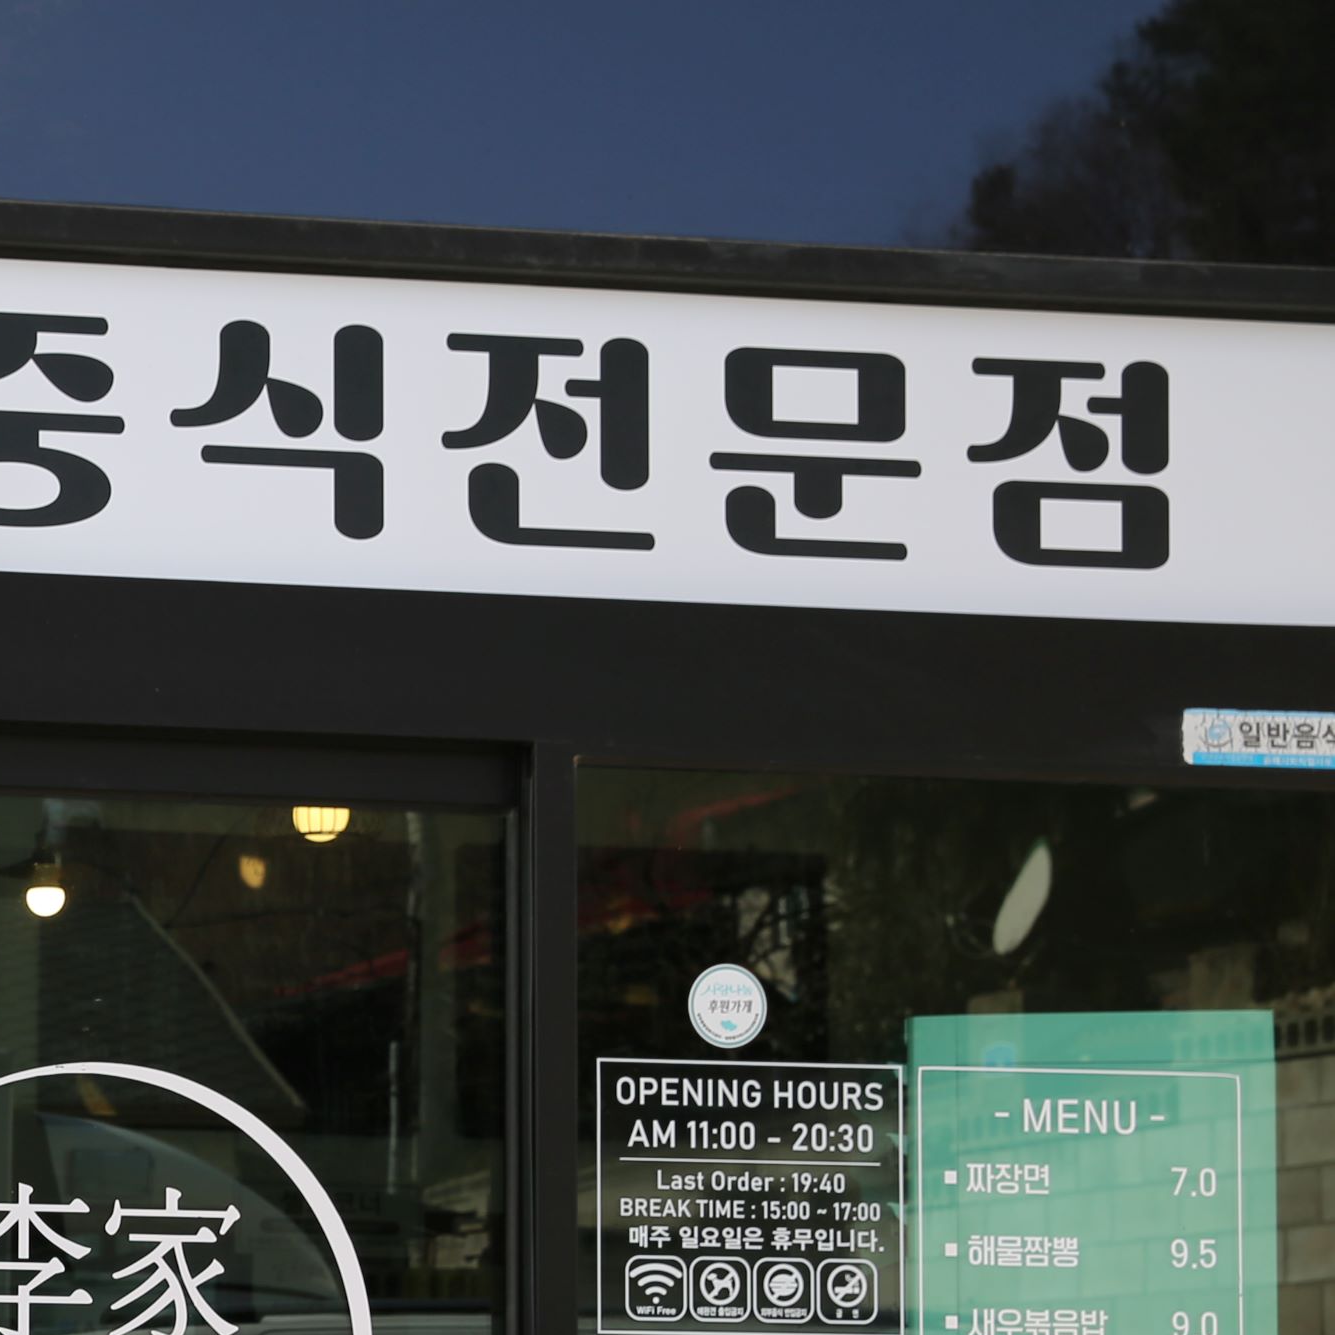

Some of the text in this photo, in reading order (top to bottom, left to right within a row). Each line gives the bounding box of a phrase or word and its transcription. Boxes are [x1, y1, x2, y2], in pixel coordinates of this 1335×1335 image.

[709, 999, 753, 1014] 후원가게
[615, 1075, 884, 1112] OPENING HOURS
[1022, 1098, 1137, 1135] MENU
[627, 1119, 676, 1148] AM
[686, 1121, 756, 1150] 11:00
[792, 1123, 874, 1153] 20:30
[657, 1169, 704, 1191] Last
[711, 1171, 774, 1192] Order
[791, 1172, 846, 1194] 19:40
[966, 1163, 1217, 1197] 짜장면 7.0
[619, 1197, 691, 1218] BREAK
[696, 1199, 746, 1219] TIME
[761, 1201, 811, 1221] 15:00
[833, 1202, 881, 1222] 17:00
[628, 1225, 885, 1253] 매주 일요일은 휴무입니다.
[967, 1235, 1218, 1269] 해물짬뽕 9.5
[636, 1305, 677, 1316] WiFi Free
